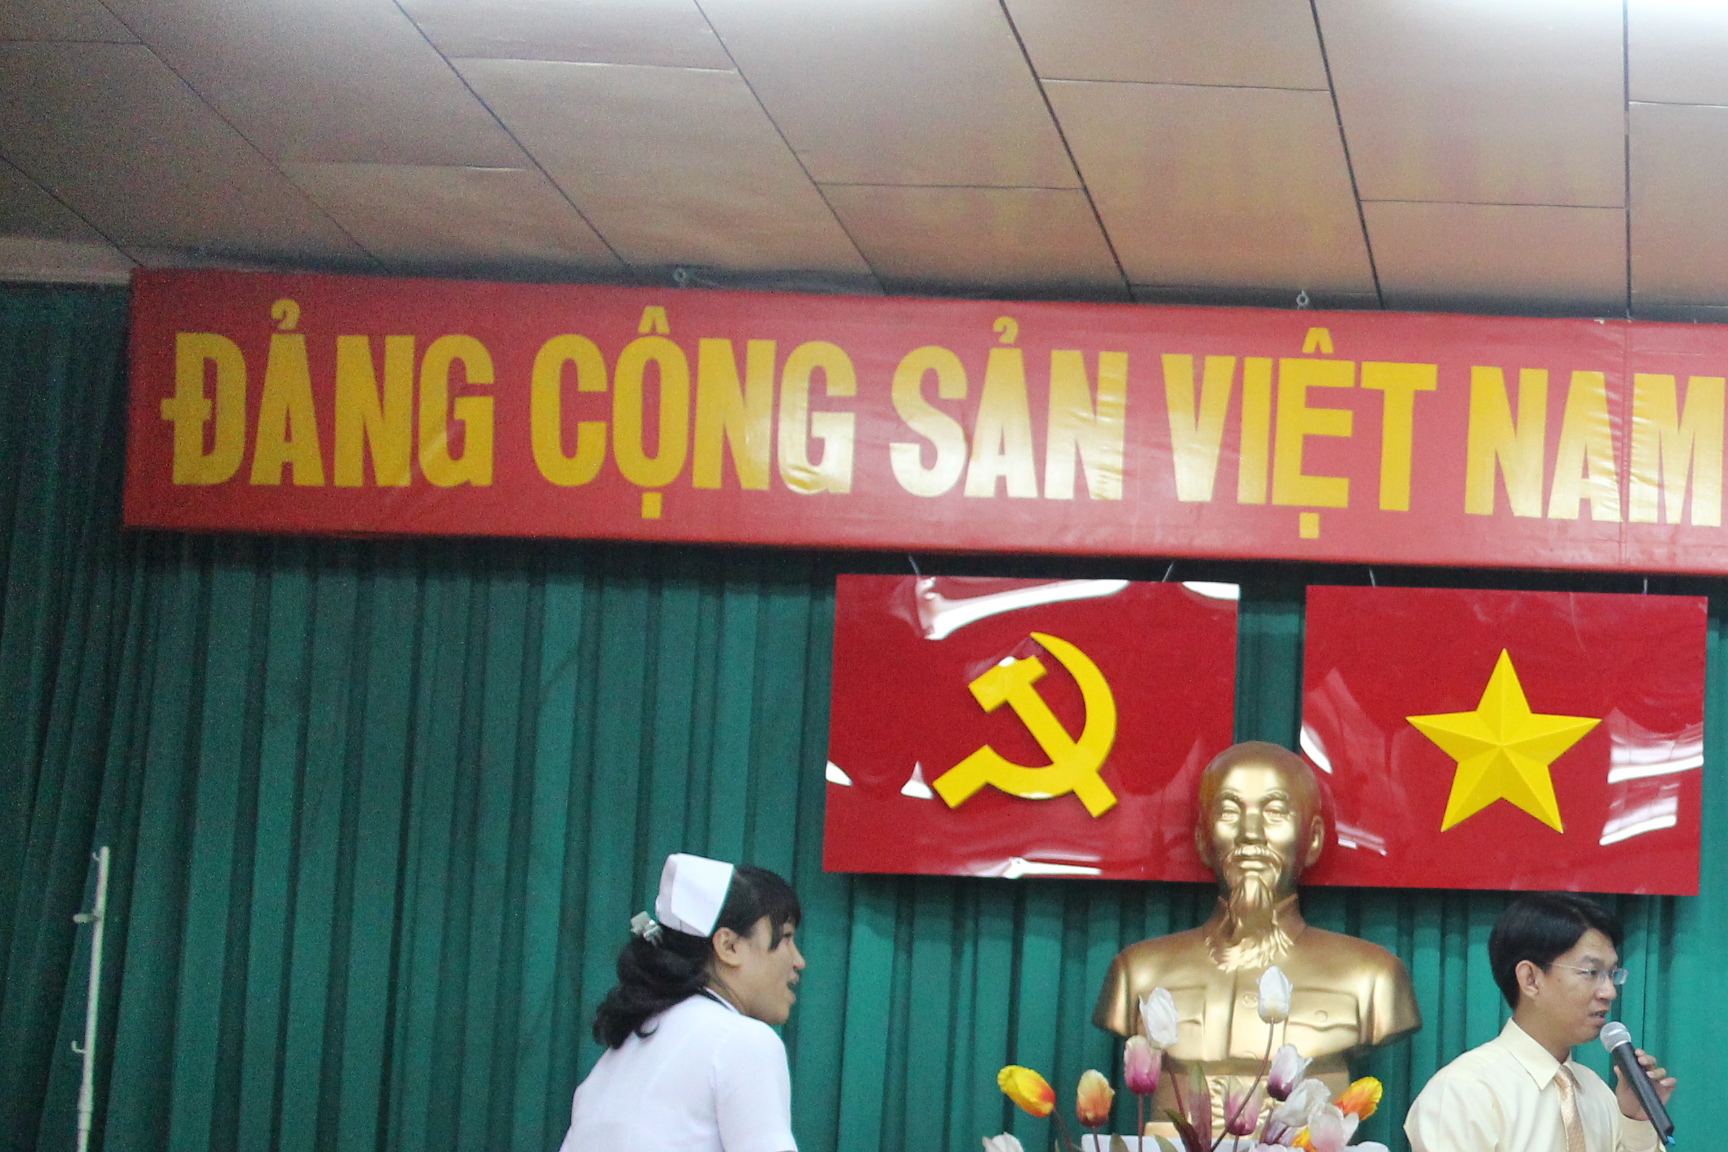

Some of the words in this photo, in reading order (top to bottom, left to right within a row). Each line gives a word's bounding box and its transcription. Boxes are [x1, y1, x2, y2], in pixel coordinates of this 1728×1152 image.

[160, 299, 494, 487] ĐẢNG
[530, 305, 857, 519] CỘNG
[889, 316, 1128, 501] SẢN
[1162, 327, 1438, 539] VIỆT
[1464, 366, 1726, 527] NAM
